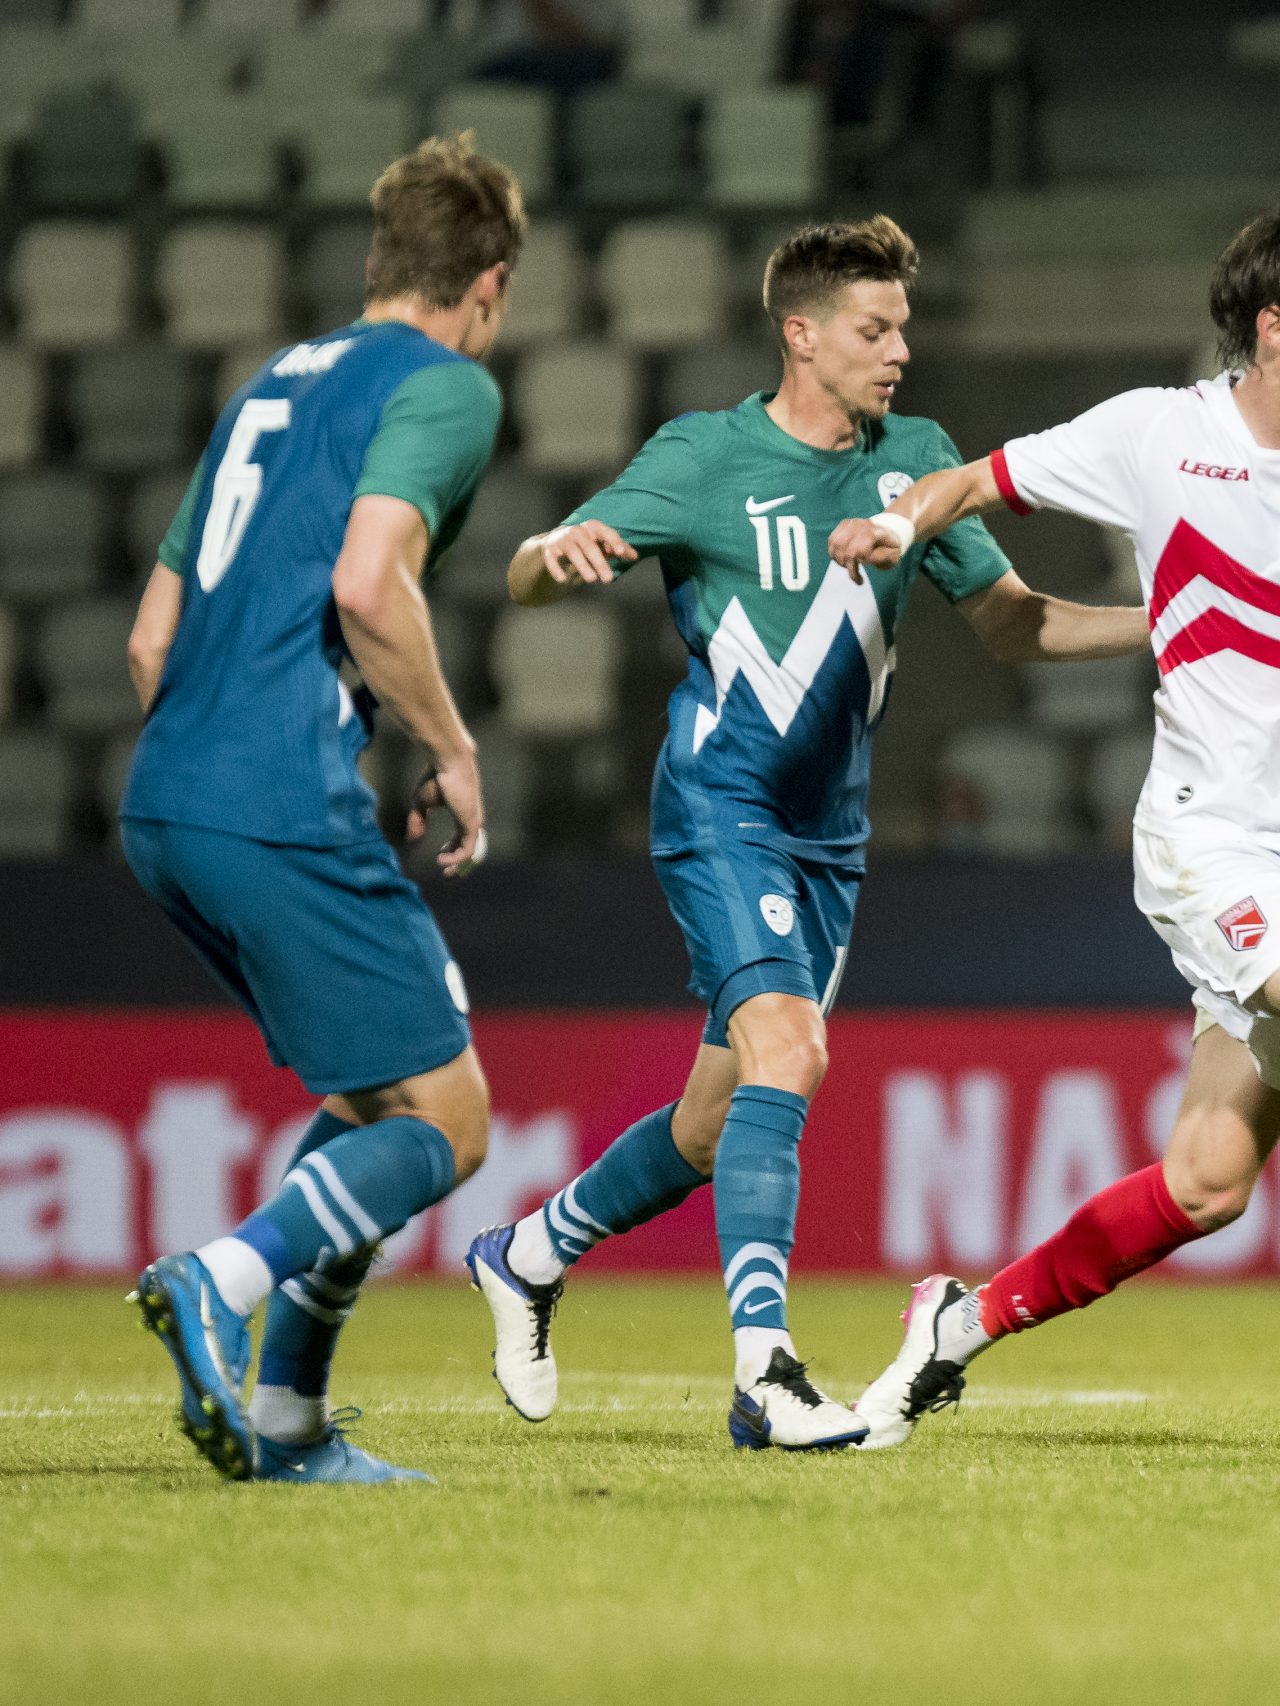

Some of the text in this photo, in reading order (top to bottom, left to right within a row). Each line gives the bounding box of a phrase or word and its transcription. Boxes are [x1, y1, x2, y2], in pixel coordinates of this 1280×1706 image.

[197, 398, 291, 593] 6
[1179, 459, 1249, 482] LEGEA
[748, 515, 810, 592] 10
